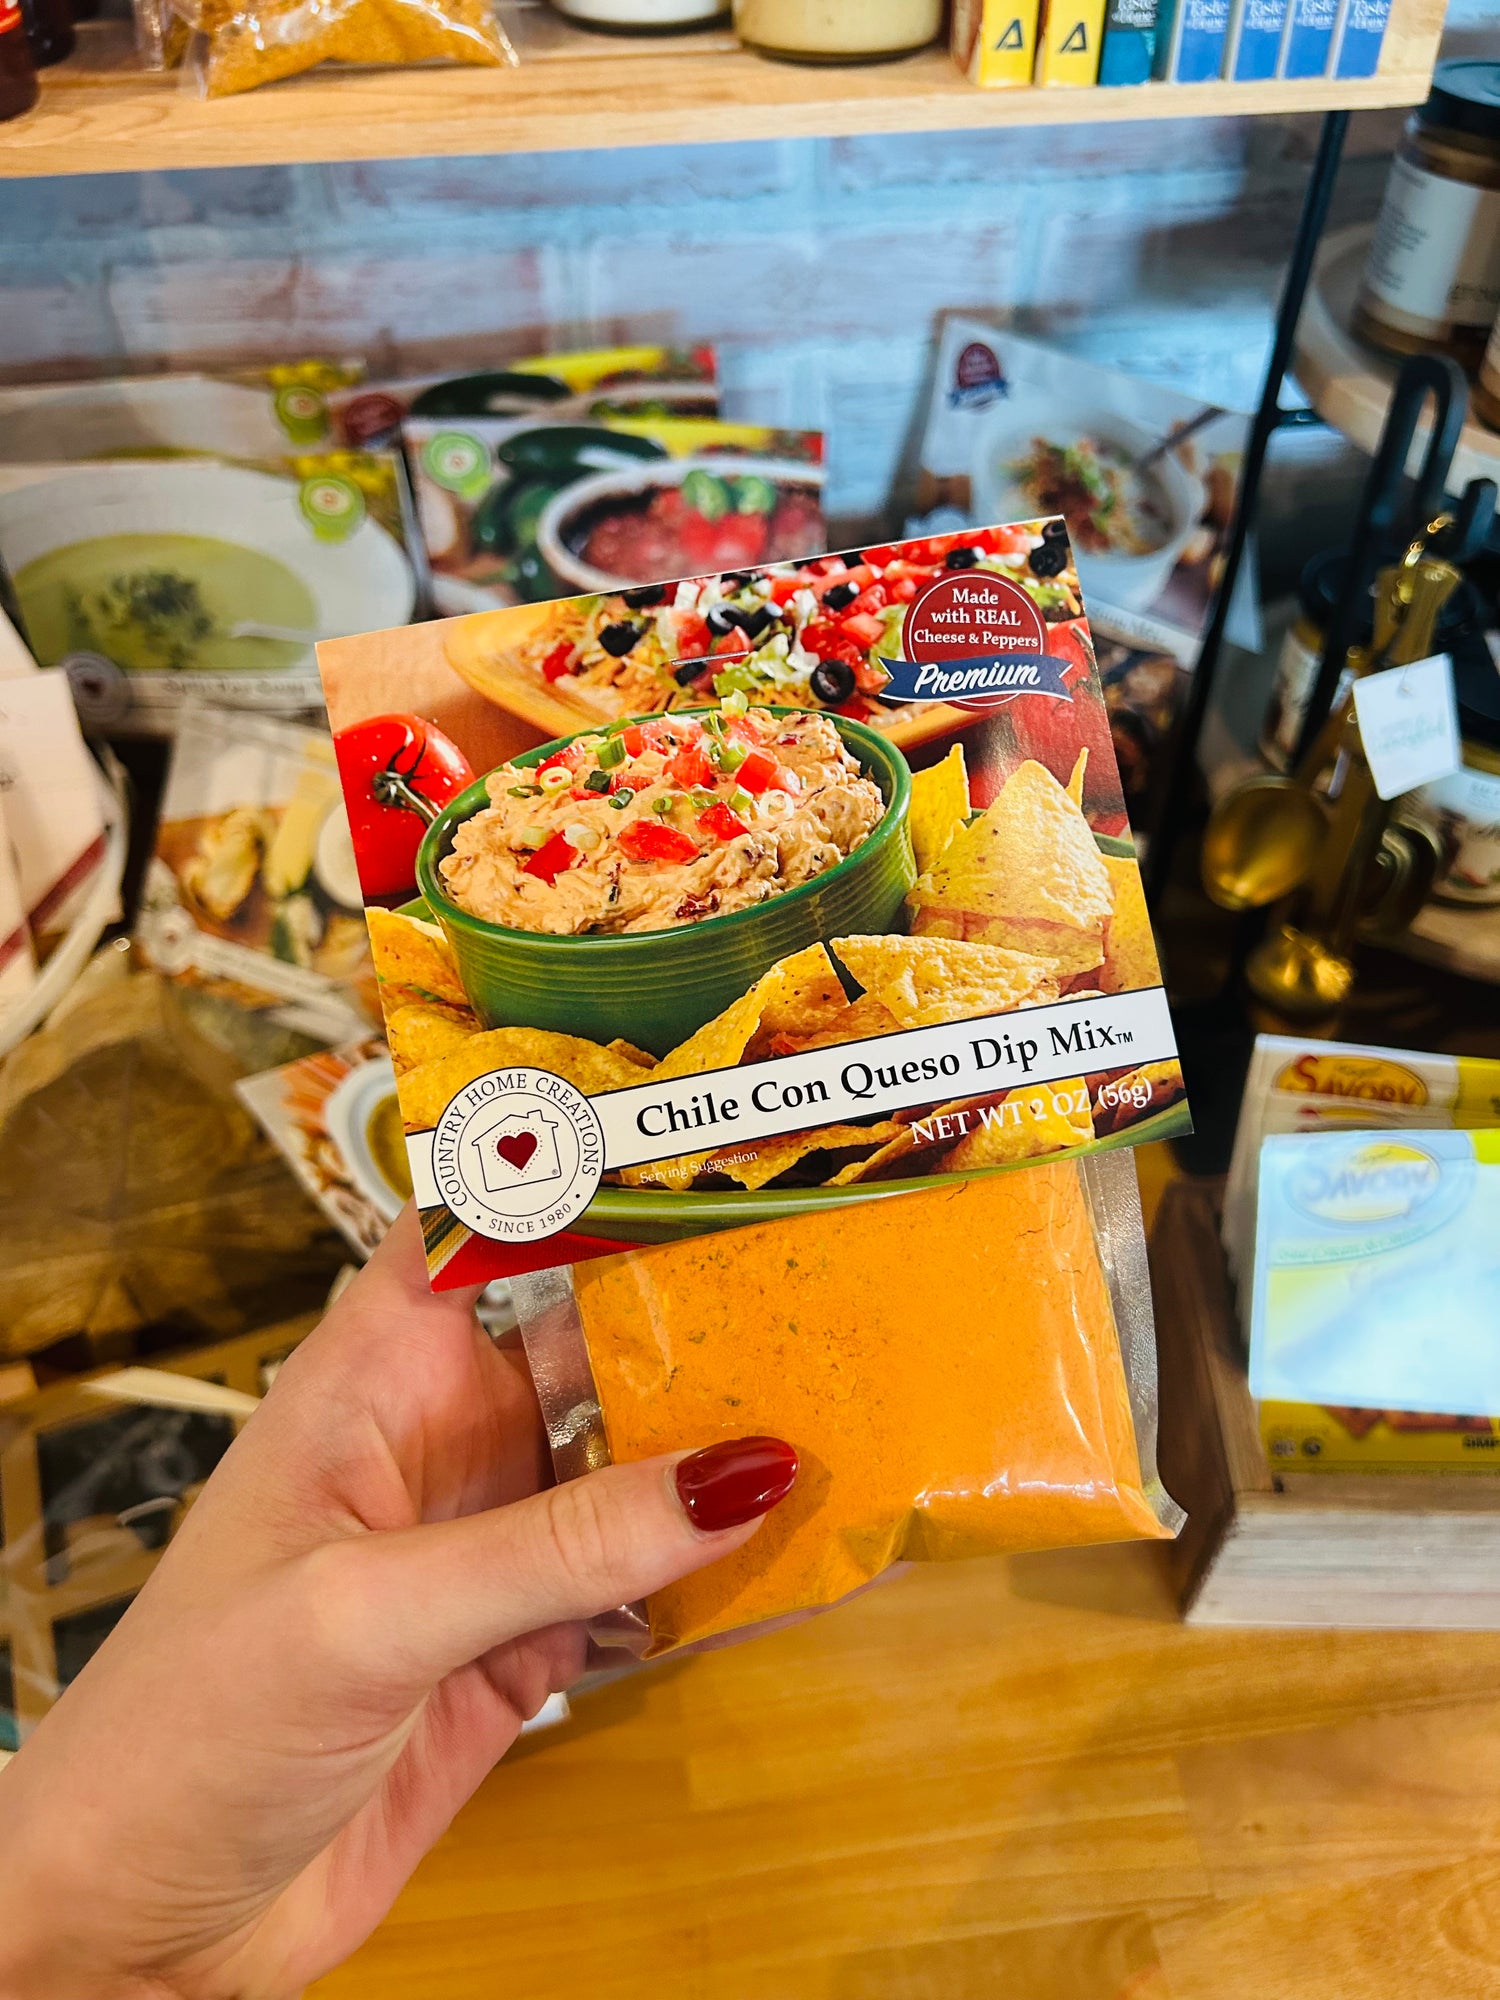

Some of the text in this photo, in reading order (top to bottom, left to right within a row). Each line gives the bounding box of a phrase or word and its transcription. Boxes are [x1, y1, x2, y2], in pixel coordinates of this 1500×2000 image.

[952, 588, 999, 605] Made
[931, 608, 1021, 626] with REAL
[914, 629, 1039, 650] Cheese & Peppers
[914, 661, 1041, 695] Premium
[636, 1092, 740, 1137] Chile
[751, 1079, 831, 1113] Con
[840, 1052, 961, 1100] Queso
[969, 1033, 1038, 1073] Dip
[908, 1076, 1153, 1146] NET WT 2 OZ (56g)
[438, 1073, 600, 1207] COUNTRY HOME CREATIONS
[639, 1149, 759, 1185] Serving Suggestion
[488, 1202, 572, 1234] SINCE 1980
